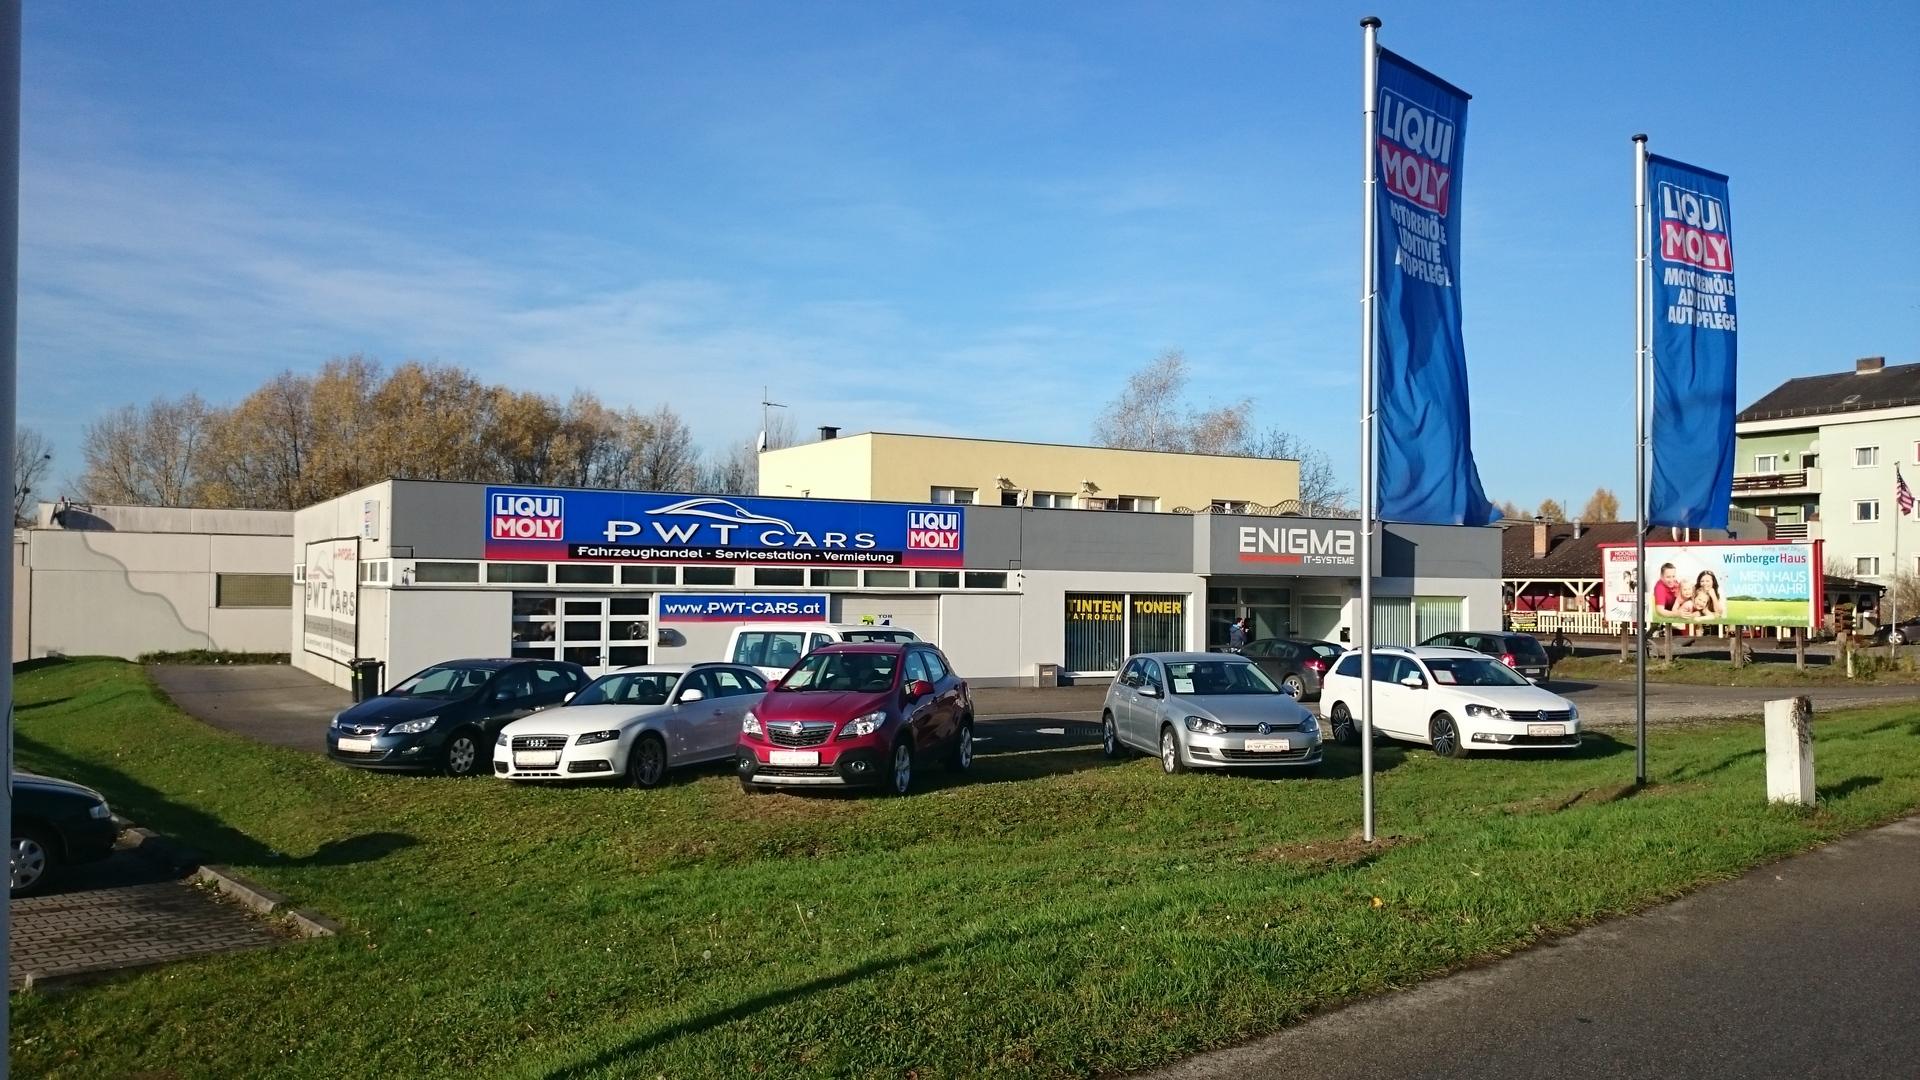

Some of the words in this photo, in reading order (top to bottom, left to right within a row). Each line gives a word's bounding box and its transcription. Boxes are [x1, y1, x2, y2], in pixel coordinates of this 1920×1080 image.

[1381, 95, 1453, 164] LIQUI
[1381, 144, 1449, 205] MOLY
[1663, 187, 1724, 232] LIQUI
[1665, 224, 1728, 268] MOLY
[1677, 288, 1727, 312] ADITIVE
[1668, 305, 1736, 332] AUTPFLEGE
[495, 496, 560, 518] LIQUI
[495, 518, 561, 538] MOLY
[910, 512, 957, 530] LIQUI
[759, 530, 876, 548] CARS
[910, 530, 958, 548] MOLY
[577, 547, 703, 560] Fahrzeughandel
[715, 549, 811, 561] Servicestation
[823, 552, 895, 564] Vermietung
[1303, 555, 1355, 565] IT-SYSTEME
[1723, 552, 1806, 566] WimbergerHaus
[1739, 570, 1769, 582] MEIN
[1773, 570, 1806, 583] HAUS
[1732, 583, 1763, 594] WIRD
[1765, 582, 1807, 594] WAHR!
[665, 602, 820, 615] www.PWT-CARS.at
[1134, 601, 1182, 614] TONER
